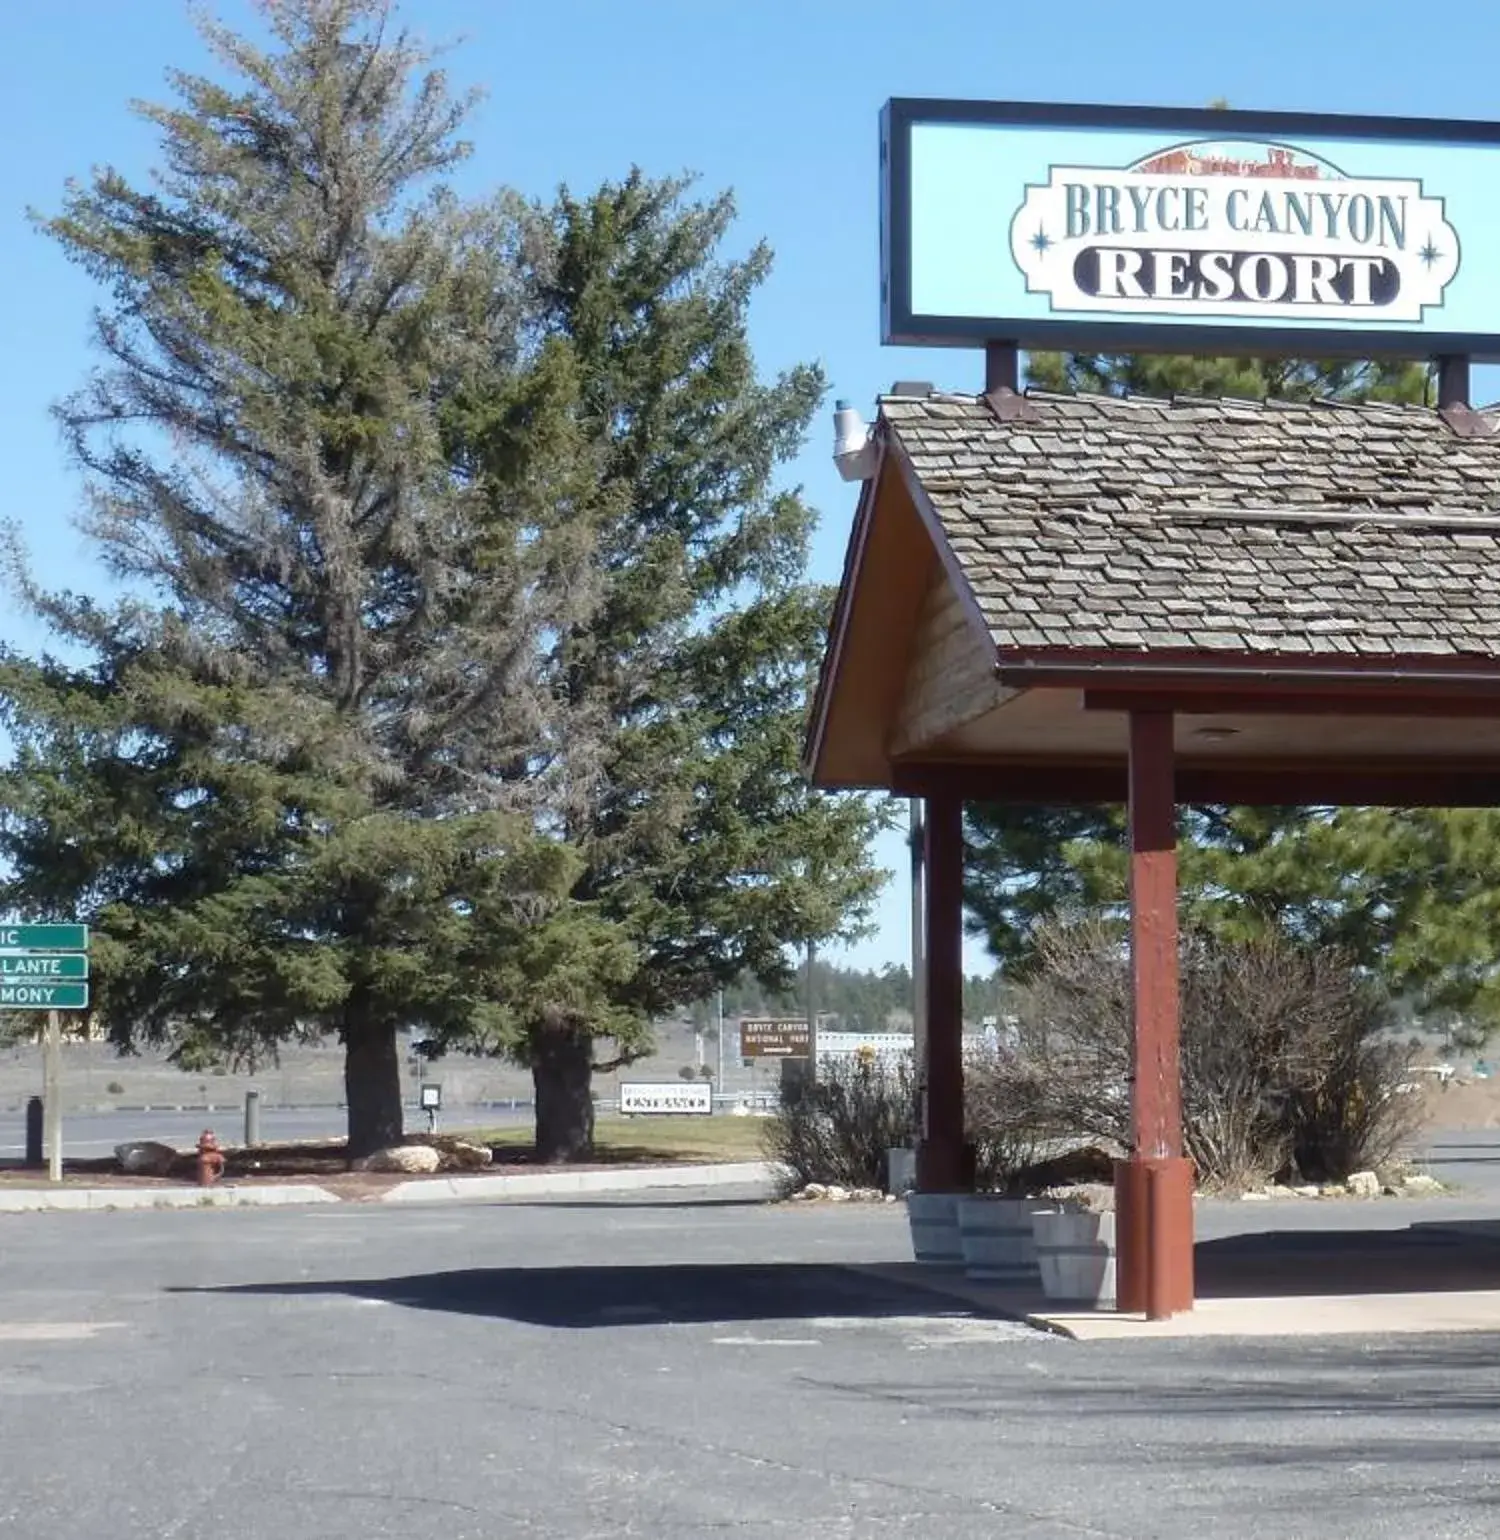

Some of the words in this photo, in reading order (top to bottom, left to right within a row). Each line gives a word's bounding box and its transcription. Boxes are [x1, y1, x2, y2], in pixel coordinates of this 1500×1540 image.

[1063, 182, 1210, 240] BRYCE
[1224, 188, 1409, 251] CANYON
[1095, 248, 1387, 306] RESORT
